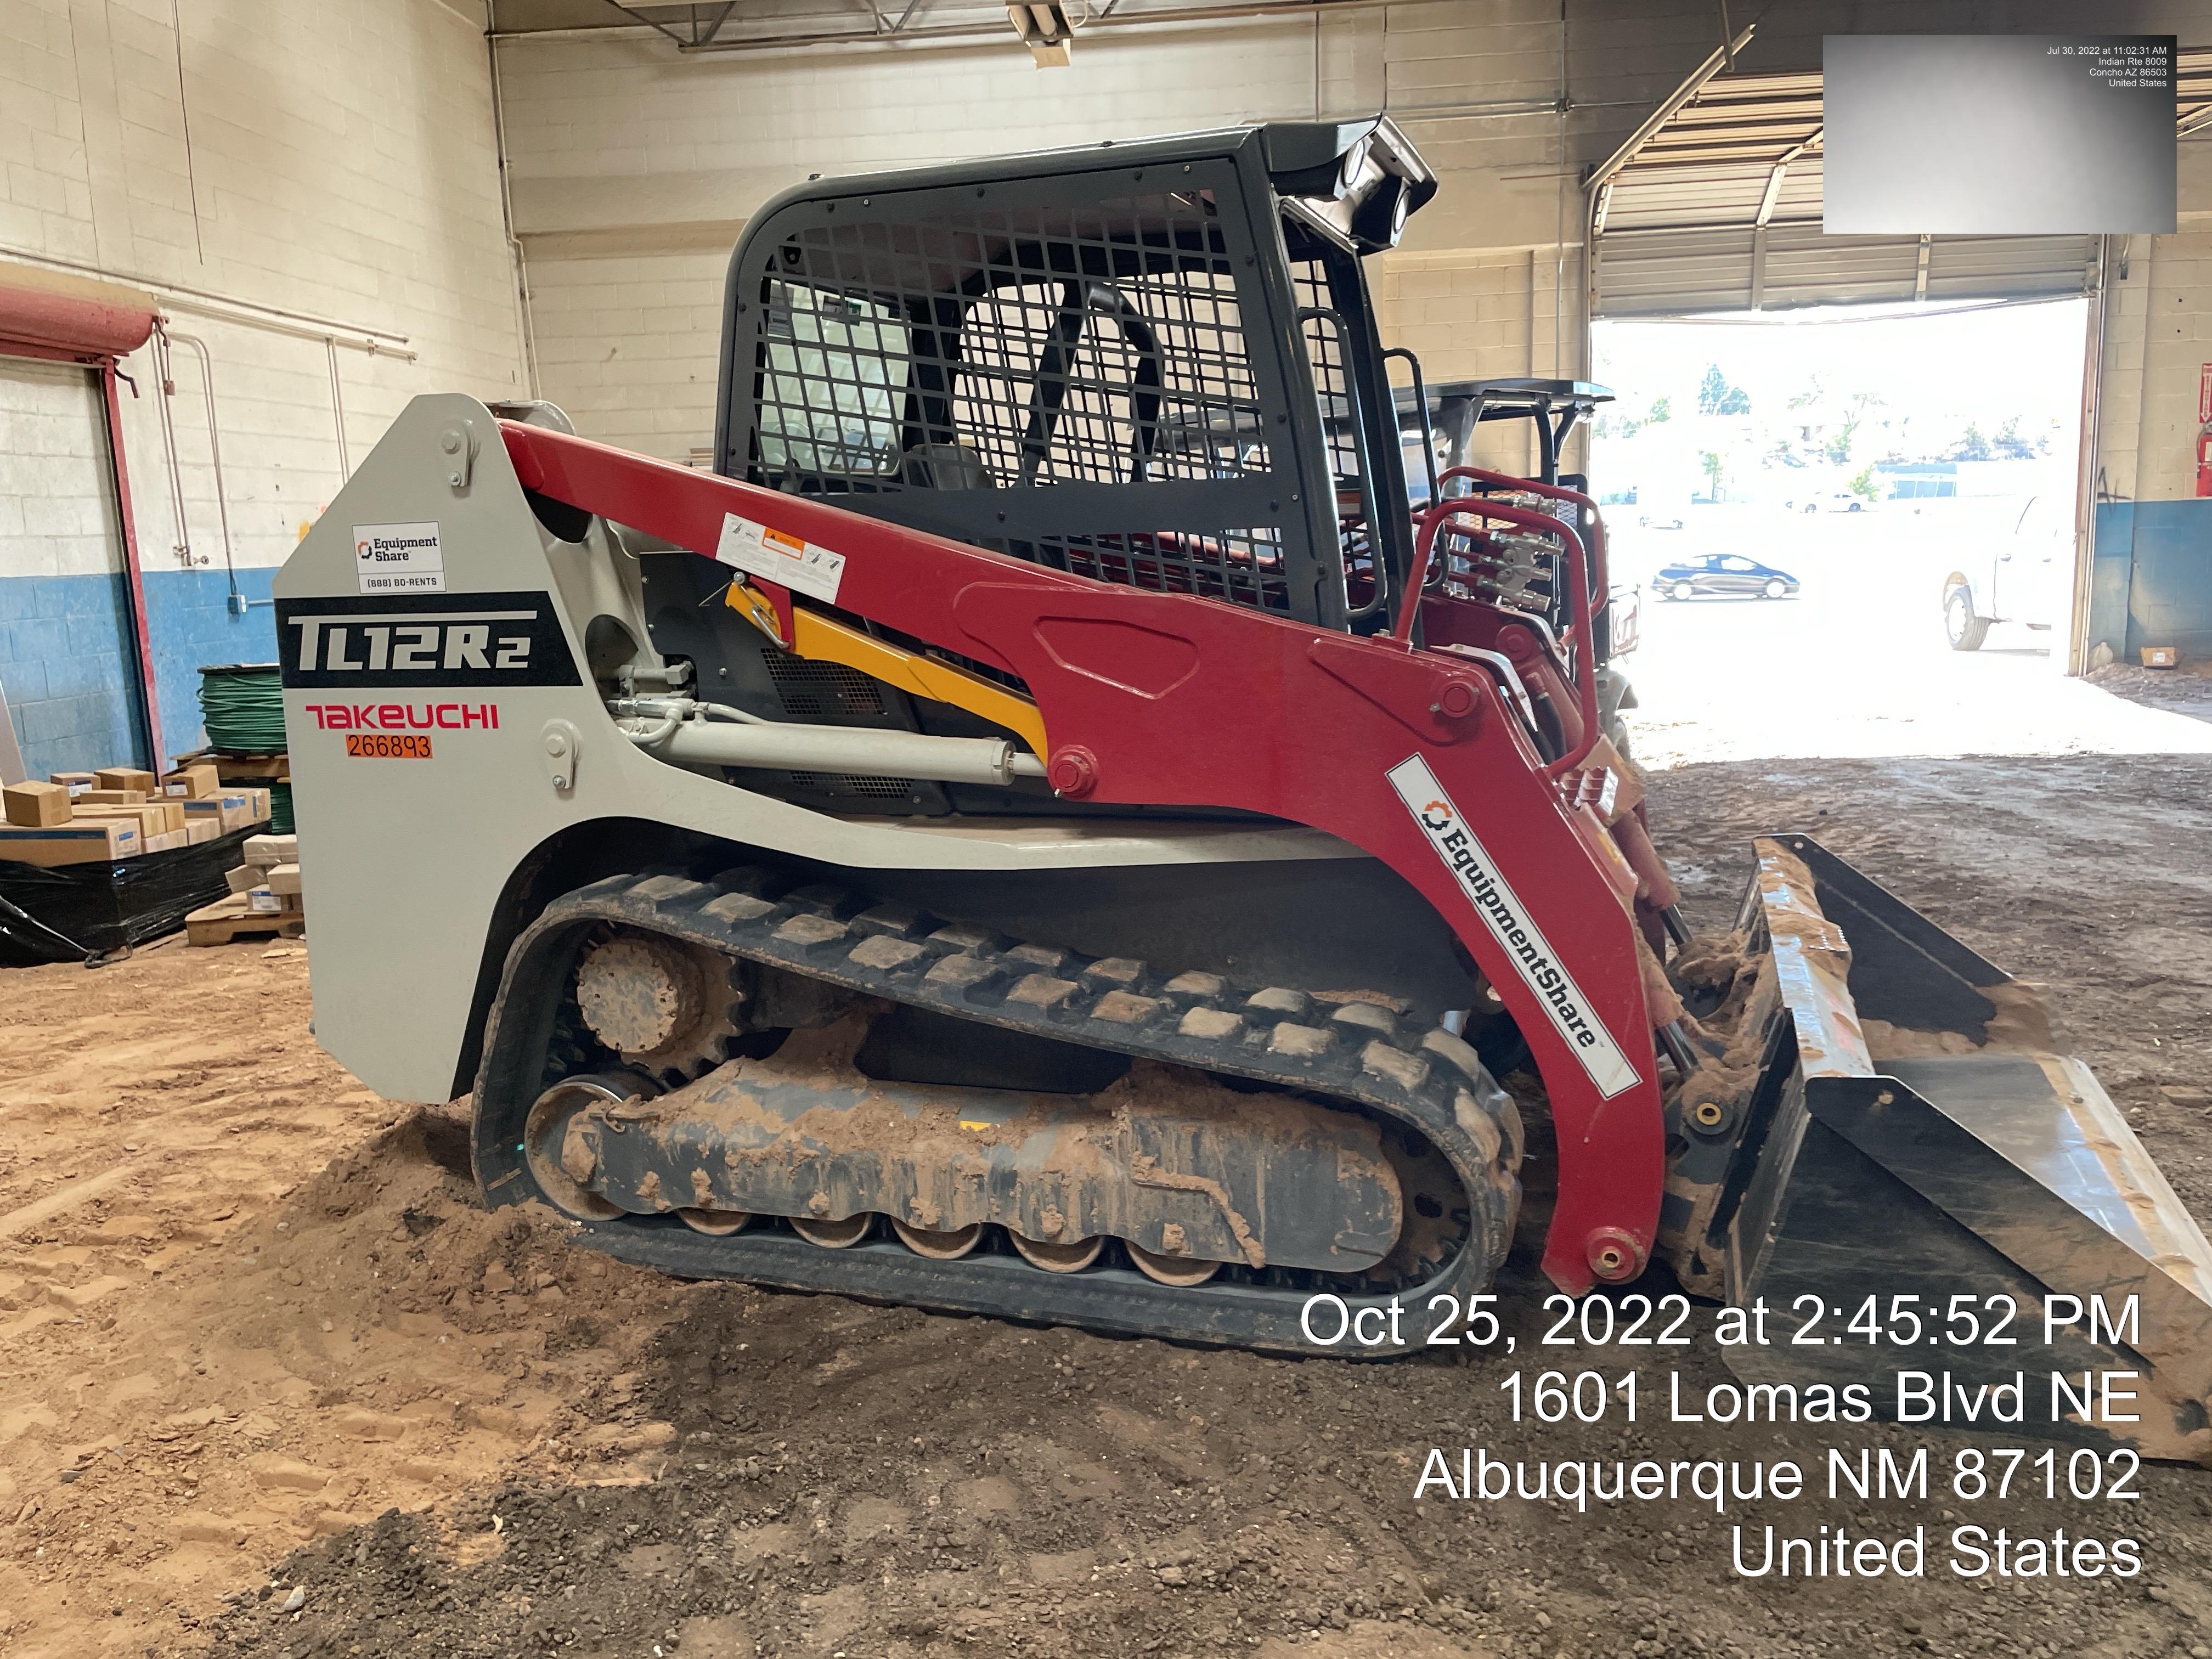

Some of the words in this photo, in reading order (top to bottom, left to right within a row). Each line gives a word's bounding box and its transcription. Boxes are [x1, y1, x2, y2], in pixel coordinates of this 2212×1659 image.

[374, 537, 438, 551] Equipment
[375, 551, 409, 562] Share
[368, 579, 391, 588] (888)
[288, 610, 537, 670] TL12R2
[349, 735, 430, 757] 266893
[1441, 828, 1596, 1048] EquipmentShare
